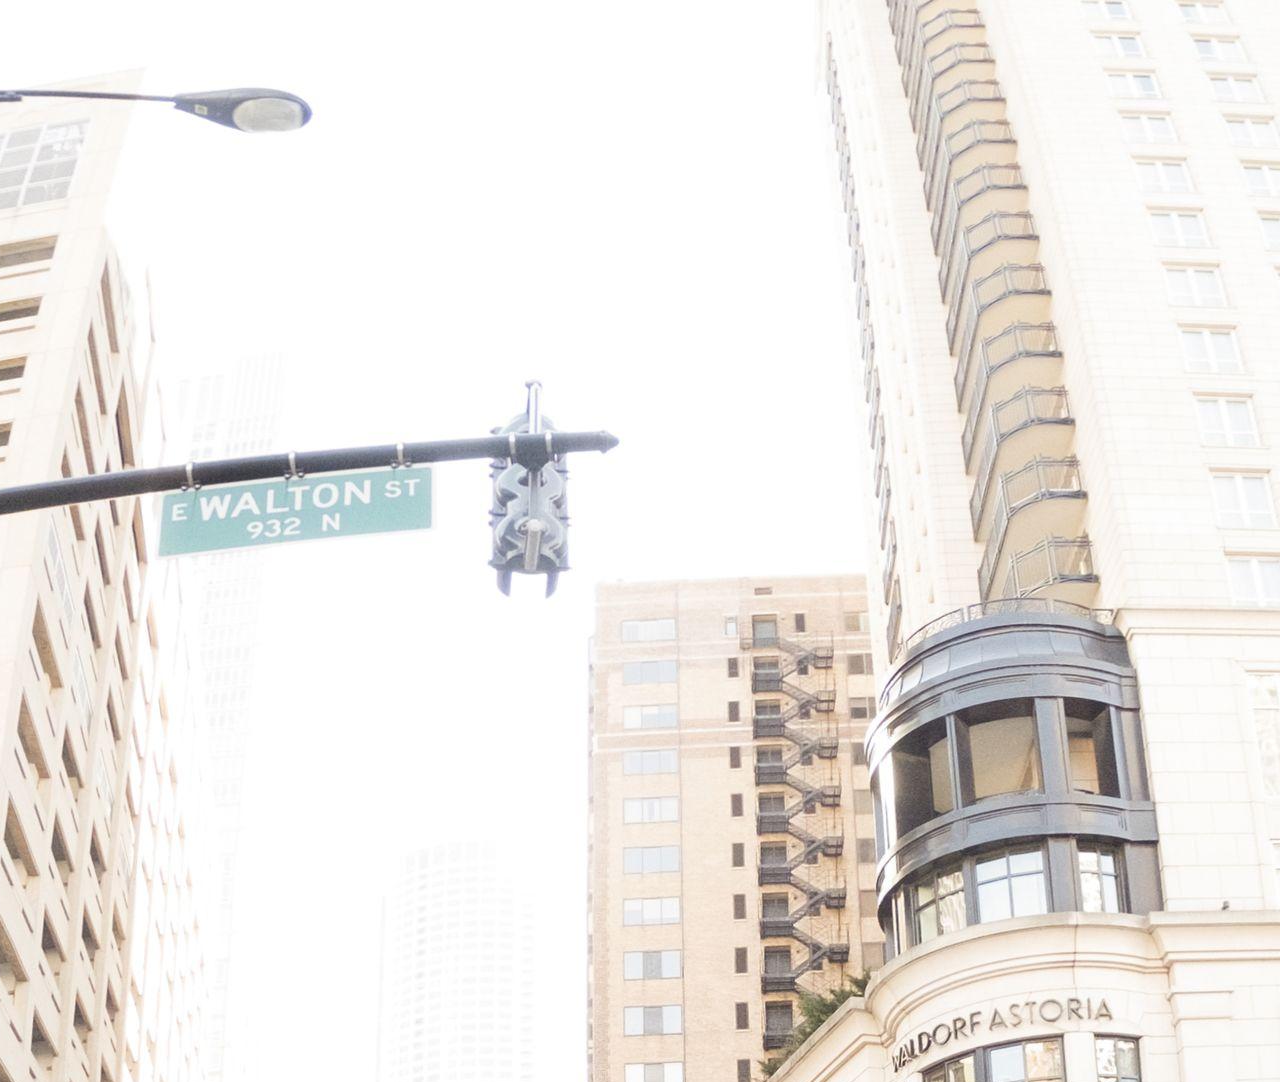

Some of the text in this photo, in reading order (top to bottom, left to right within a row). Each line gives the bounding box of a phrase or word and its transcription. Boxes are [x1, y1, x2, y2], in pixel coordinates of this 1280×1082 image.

[171, 478, 421, 522] E WALTON ST
[246, 512, 341, 540] 932 N
[891, 997, 1114, 1073] WALDORF ASTORIA
